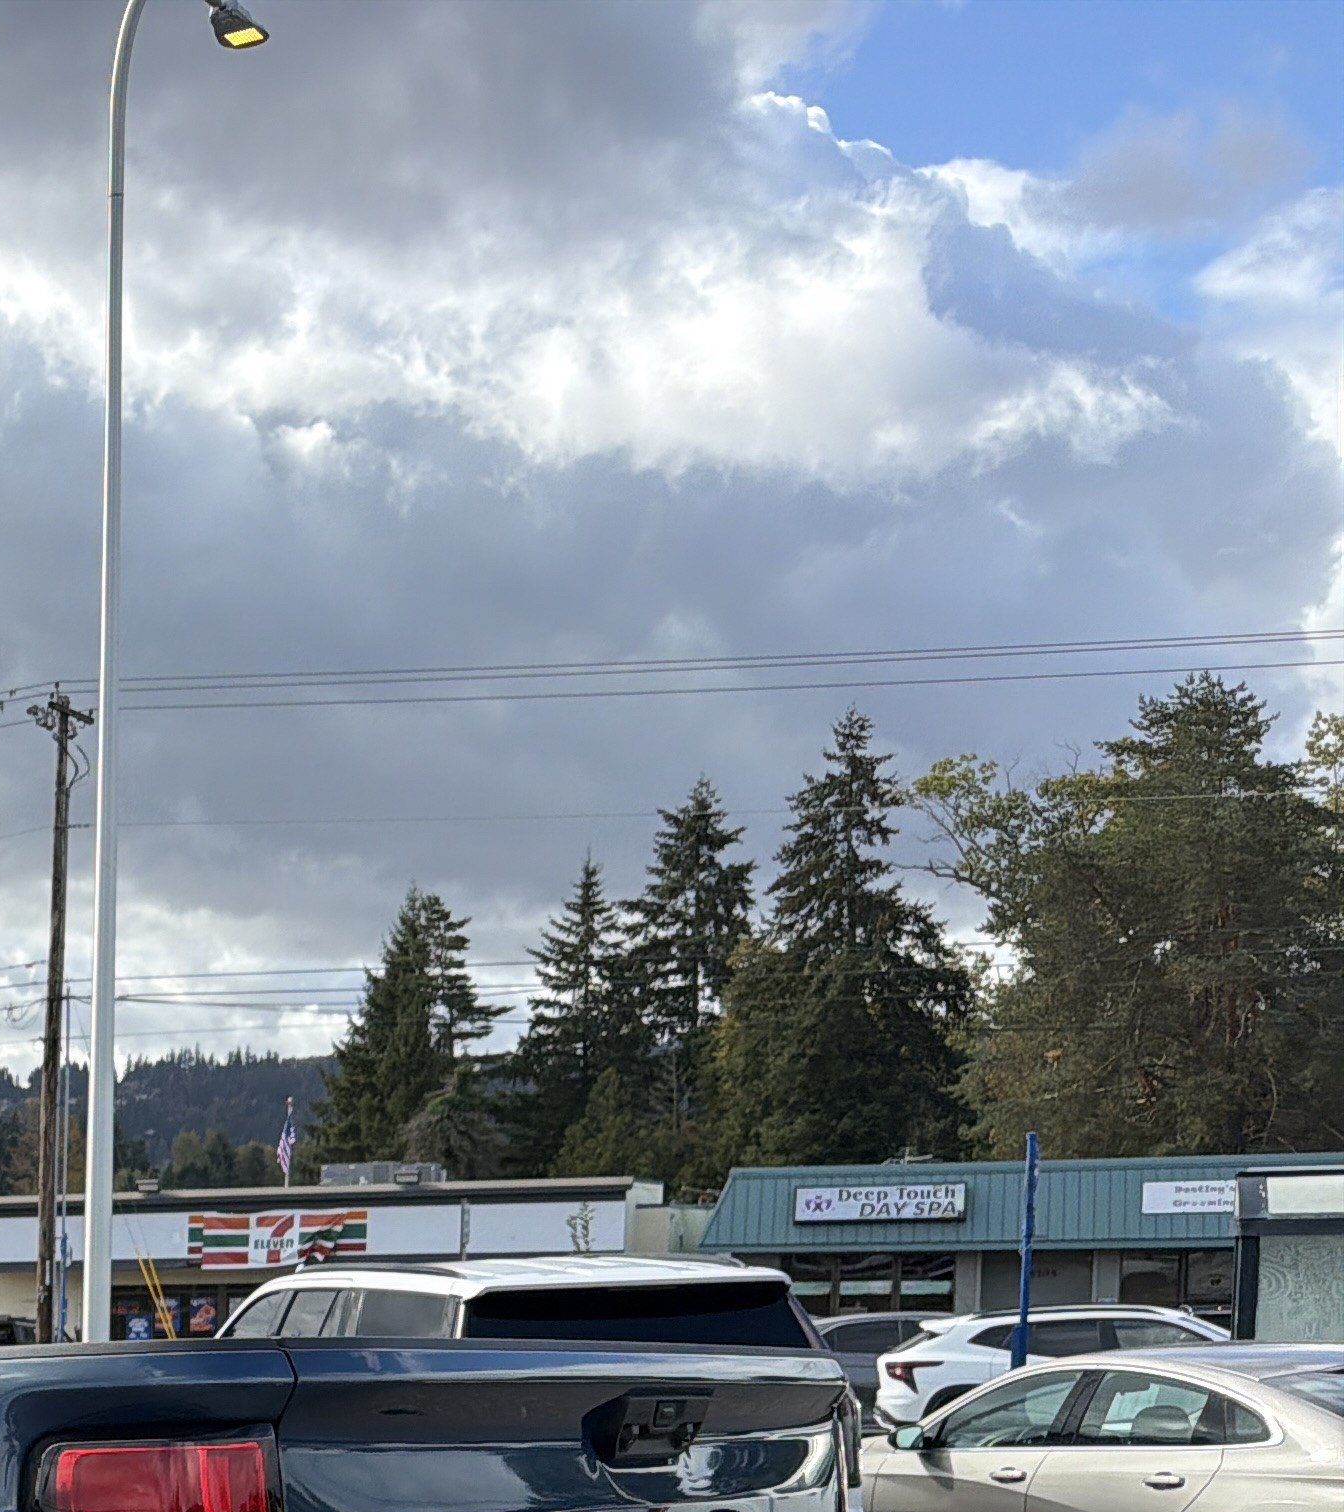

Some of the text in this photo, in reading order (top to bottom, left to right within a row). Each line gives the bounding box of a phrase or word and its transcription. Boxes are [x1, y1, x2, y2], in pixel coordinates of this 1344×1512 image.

[837, 1185, 957, 1204] Deep Touch
[859, 1200, 957, 1218] DAY SPA
[255, 1213, 295, 1264] 7
